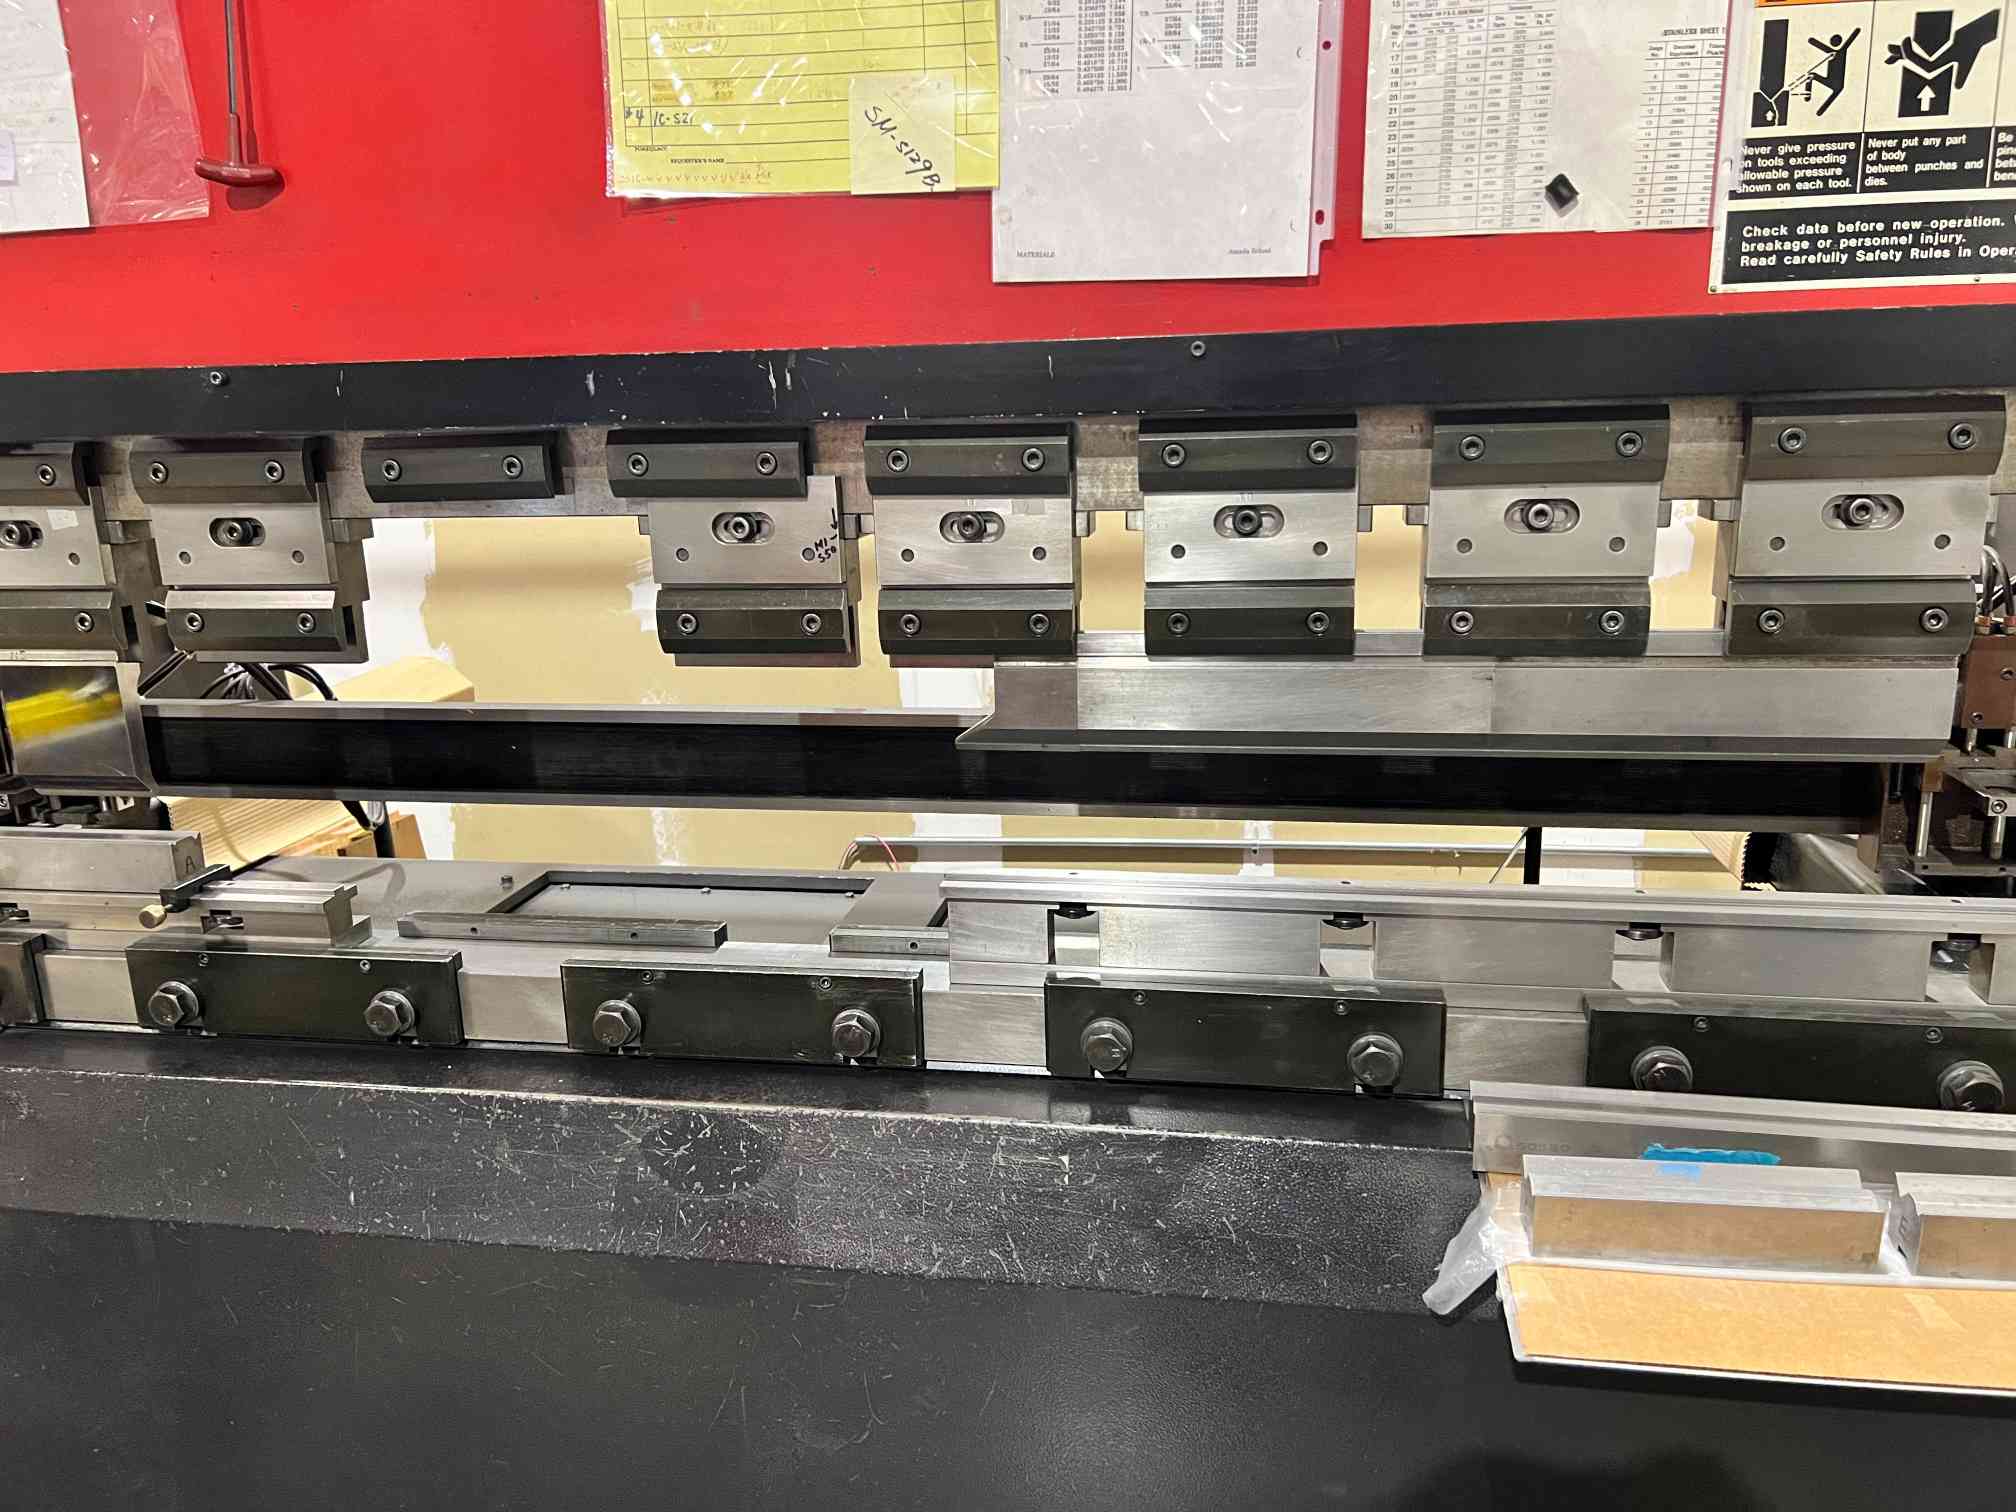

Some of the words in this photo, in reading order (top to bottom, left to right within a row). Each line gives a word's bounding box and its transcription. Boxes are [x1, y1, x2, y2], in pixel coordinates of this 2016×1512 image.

[1868, 138, 1898, 148] Never
[1901, 136, 1919, 148] put
[1923, 136, 1941, 147] any
[1945, 134, 1967, 146] part
[1998, 132, 2014, 143] Be
[1778, 143, 1801, 155] give
[1807, 141, 1856, 152] pressure
[1996, 145, 2016, 157] pin
[1757, 157, 1784, 167] tools
[1789, 153, 1847, 165] exceeding
[1866, 151, 1877, 161] of
[1881, 150, 1906, 161] body
[1794, 167, 1843, 179] pressure
[1865, 163, 1908, 174] between
[1914, 160, 1958, 173] punches
[1964, 158, 1984, 169] and
[1864, 176, 1888, 187] dies.
[1993, 171, 2016, 181] ben
[1736, 183, 1771, 193] shown
[1777, 182, 1791, 191] on
[1796, 179, 1823, 190] each
[1828, 177, 1852, 188] tool.
[1742, 225, 1788, 237] Check
[1796, 223, 1828, 235] data
[1837, 220, 1885, 233] before
[1892, 220, 1922, 230] new
[1930, 215, 2005, 230] operation.
[1741, 240, 1810, 252] breakage
[1817, 239, 1832, 249] or
[1840, 233, 1913, 249] personnel
[1920, 232, 1966, 246] injury.
[1740, 255, 1777, 267] Read
[1783, 251, 1848, 264] carefully
[1856, 248, 1902, 262] Safety
[1910, 247, 1951, 259] Rules
[1958, 246, 1971, 257] in
[1979, 244, 2016, 258] Oper
